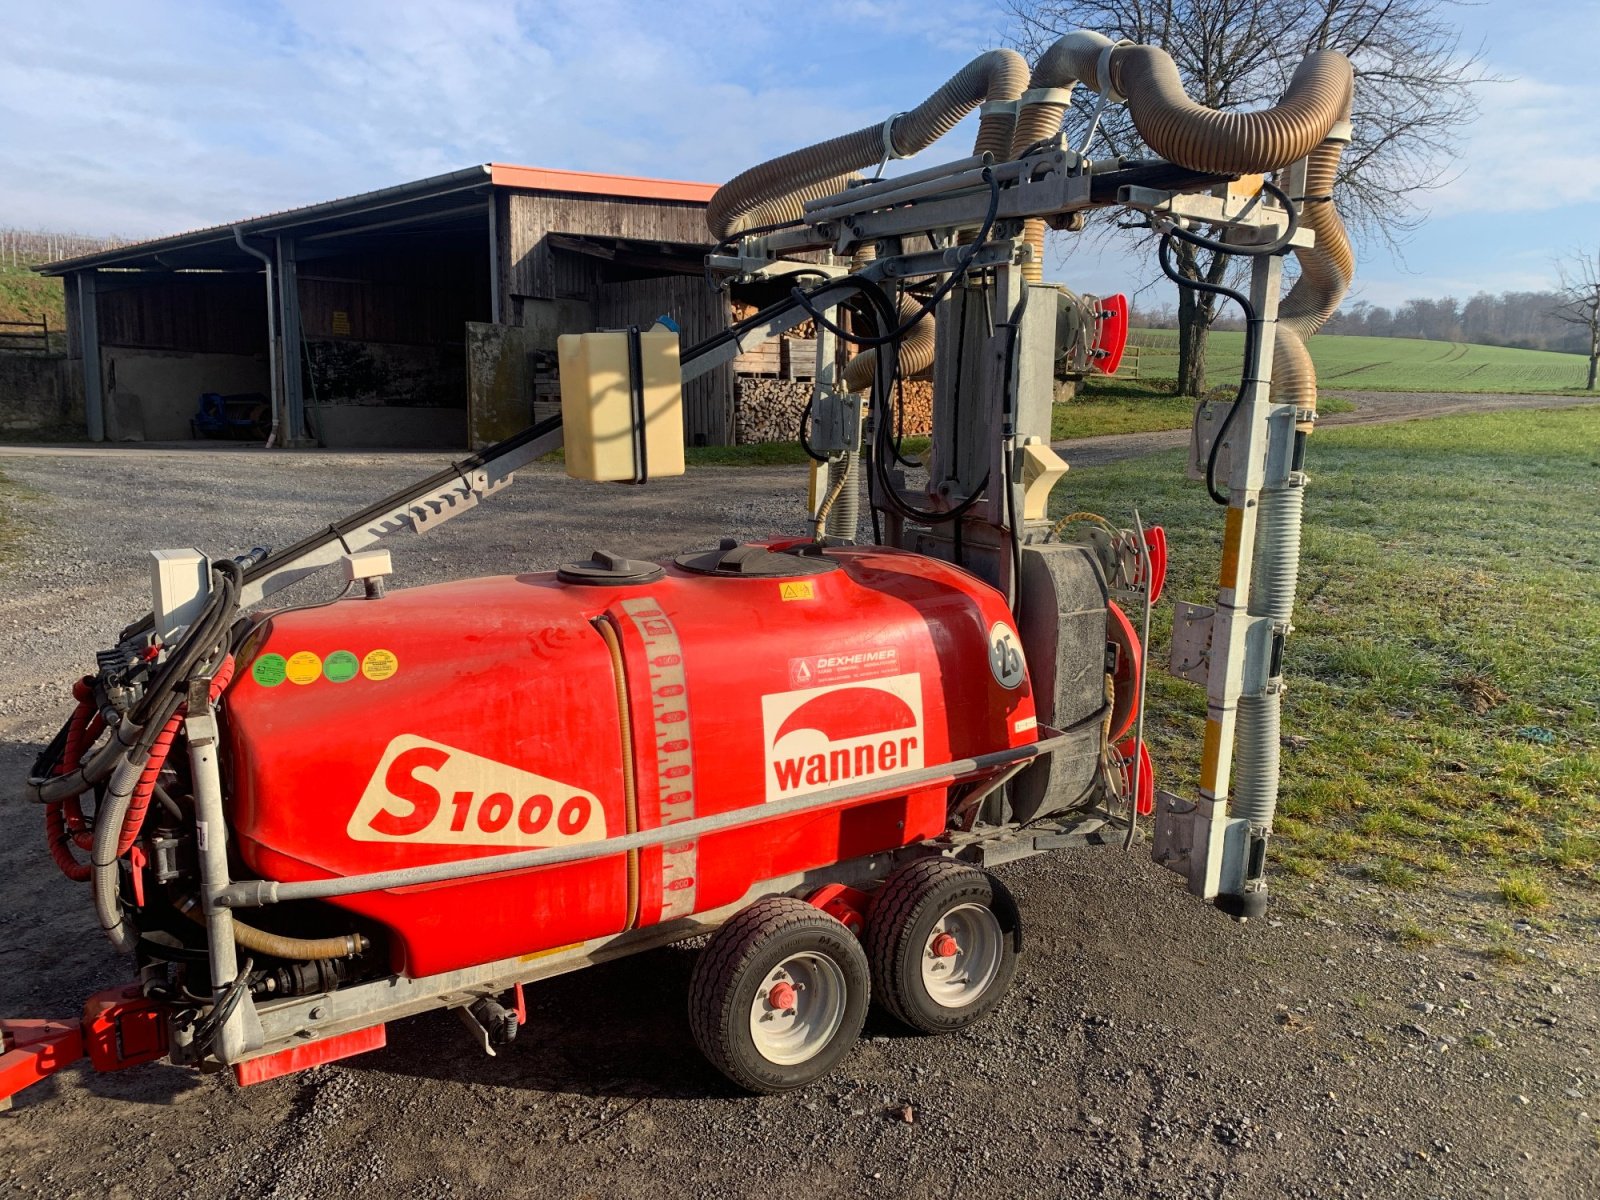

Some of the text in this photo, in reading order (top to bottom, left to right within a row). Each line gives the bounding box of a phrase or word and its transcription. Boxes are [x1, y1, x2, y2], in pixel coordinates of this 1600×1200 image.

[817, 649, 896, 668] DEXHEIMER
[996, 634, 1021, 679] 25
[773, 736, 918, 792] wanner
[674, 879, 689, 889] 200
[937, 887, 992, 911] MAXXIS
